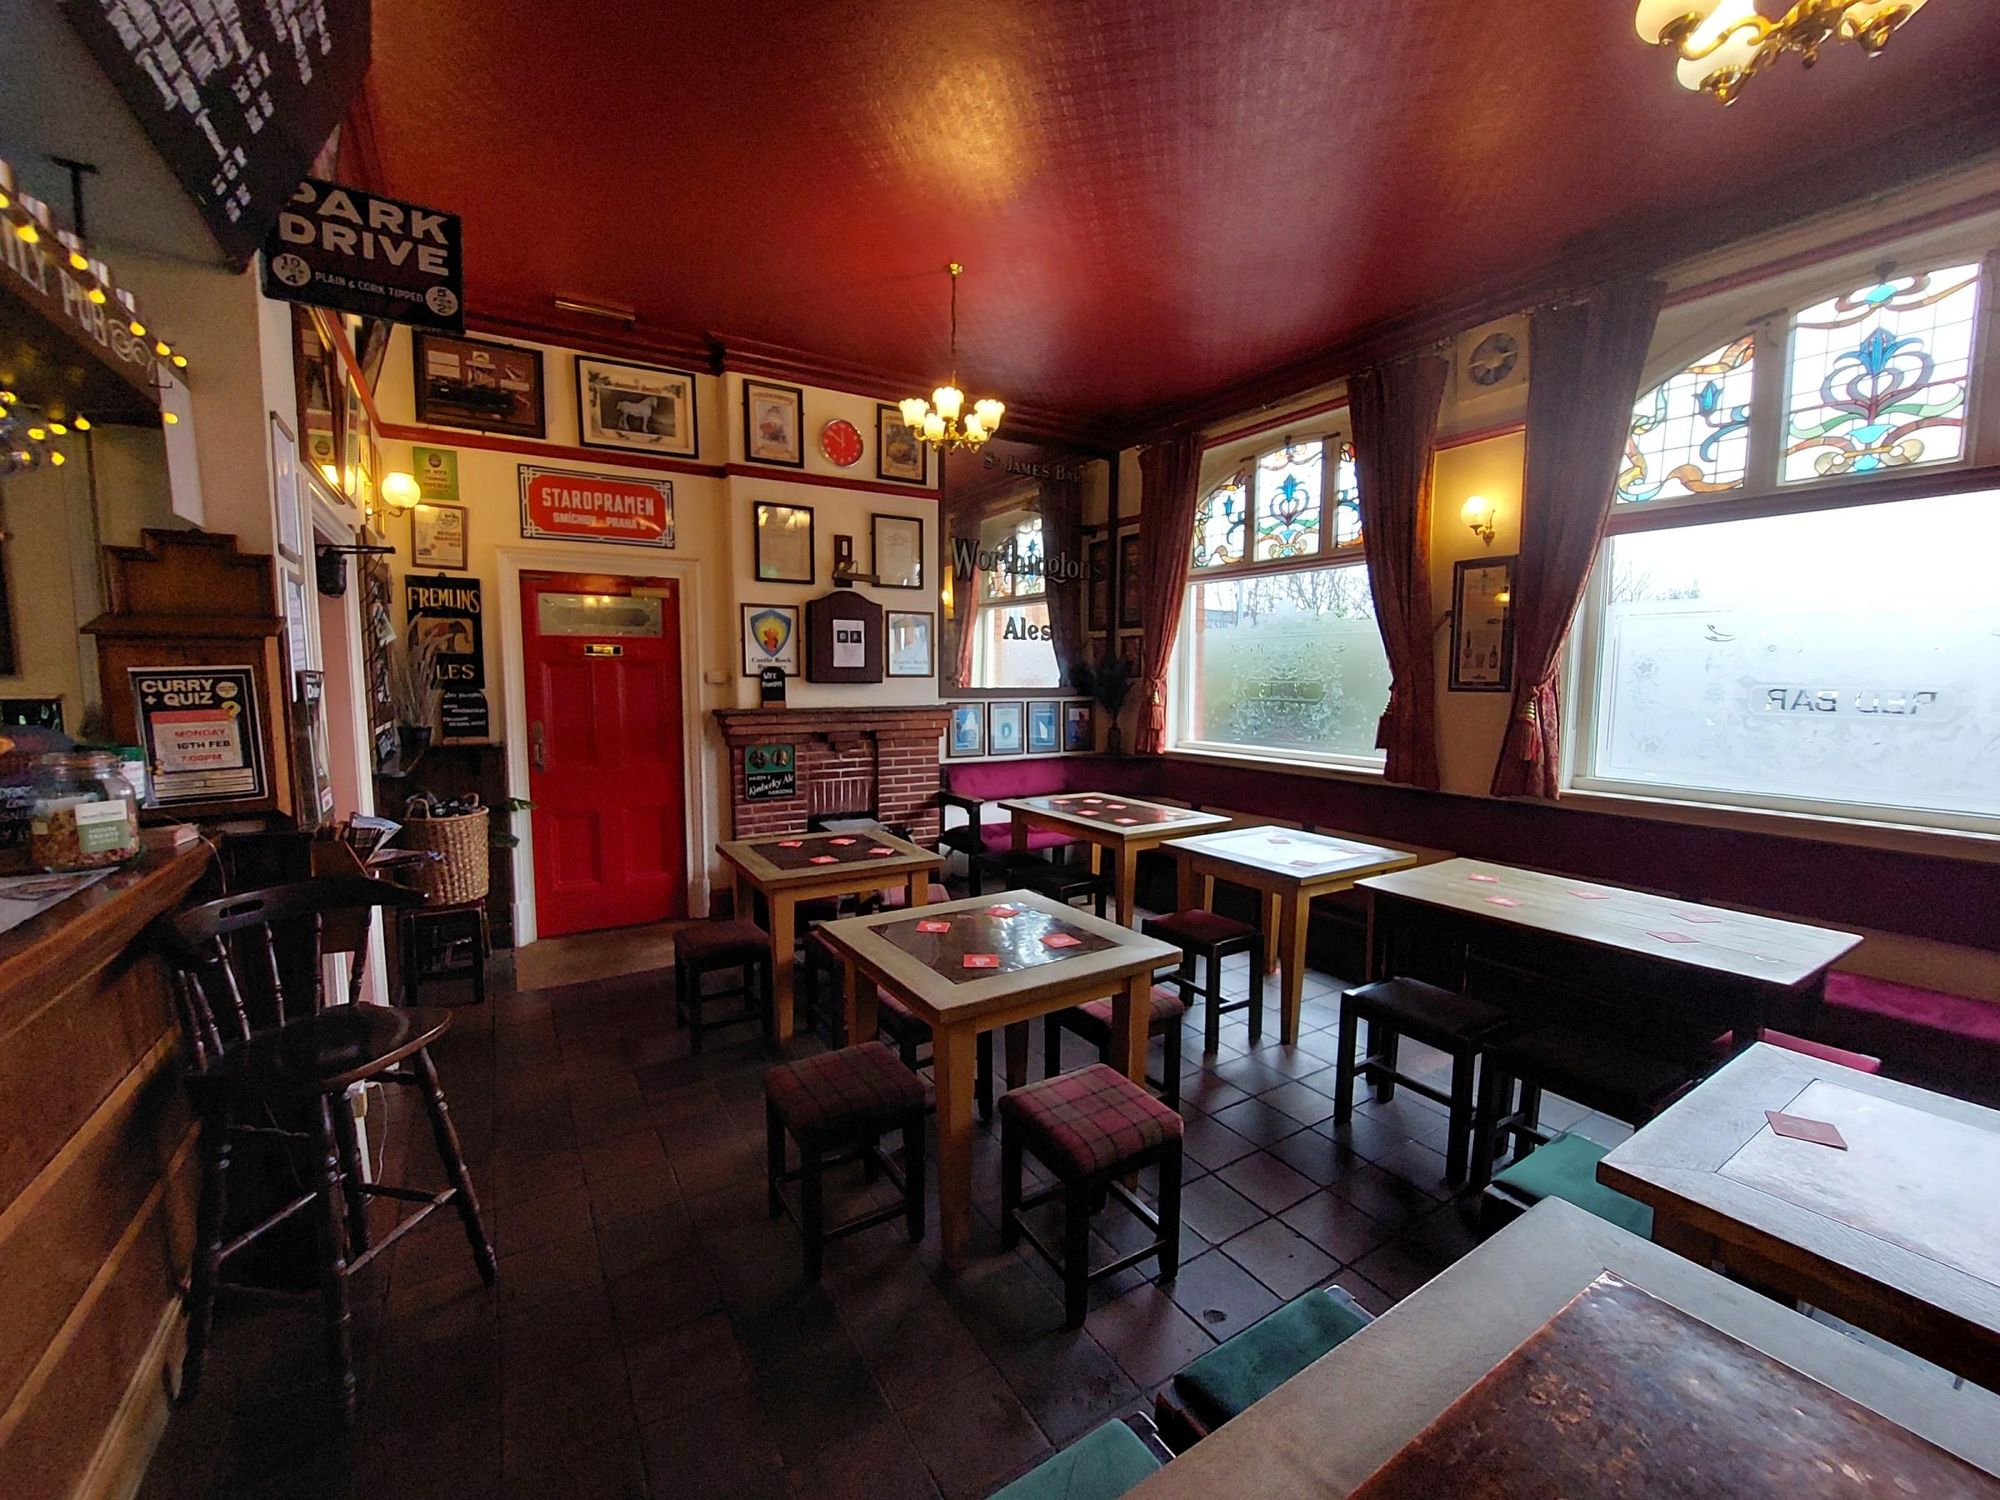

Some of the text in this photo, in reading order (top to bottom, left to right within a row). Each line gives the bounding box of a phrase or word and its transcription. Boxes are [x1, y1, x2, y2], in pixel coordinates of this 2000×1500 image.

[278, 211, 449, 277] DRIVE
[315, 271, 346, 287] PLAIN
[357, 280, 385, 295] CORK
[389, 287, 424, 302] TIPPED
[1005, 456, 1050, 479] JAMES
[541, 487, 655, 517] STAROPRAMEN
[407, 586, 480, 614] FREMLINS
[1003, 616, 1052, 642] Ales
[436, 664, 475, 680] LES
[141, 678, 214, 693] CURRY
[163, 692, 214, 707] QUIZ
[174, 728, 227, 738] MONDAY
[208, 740, 231, 748] FEB
